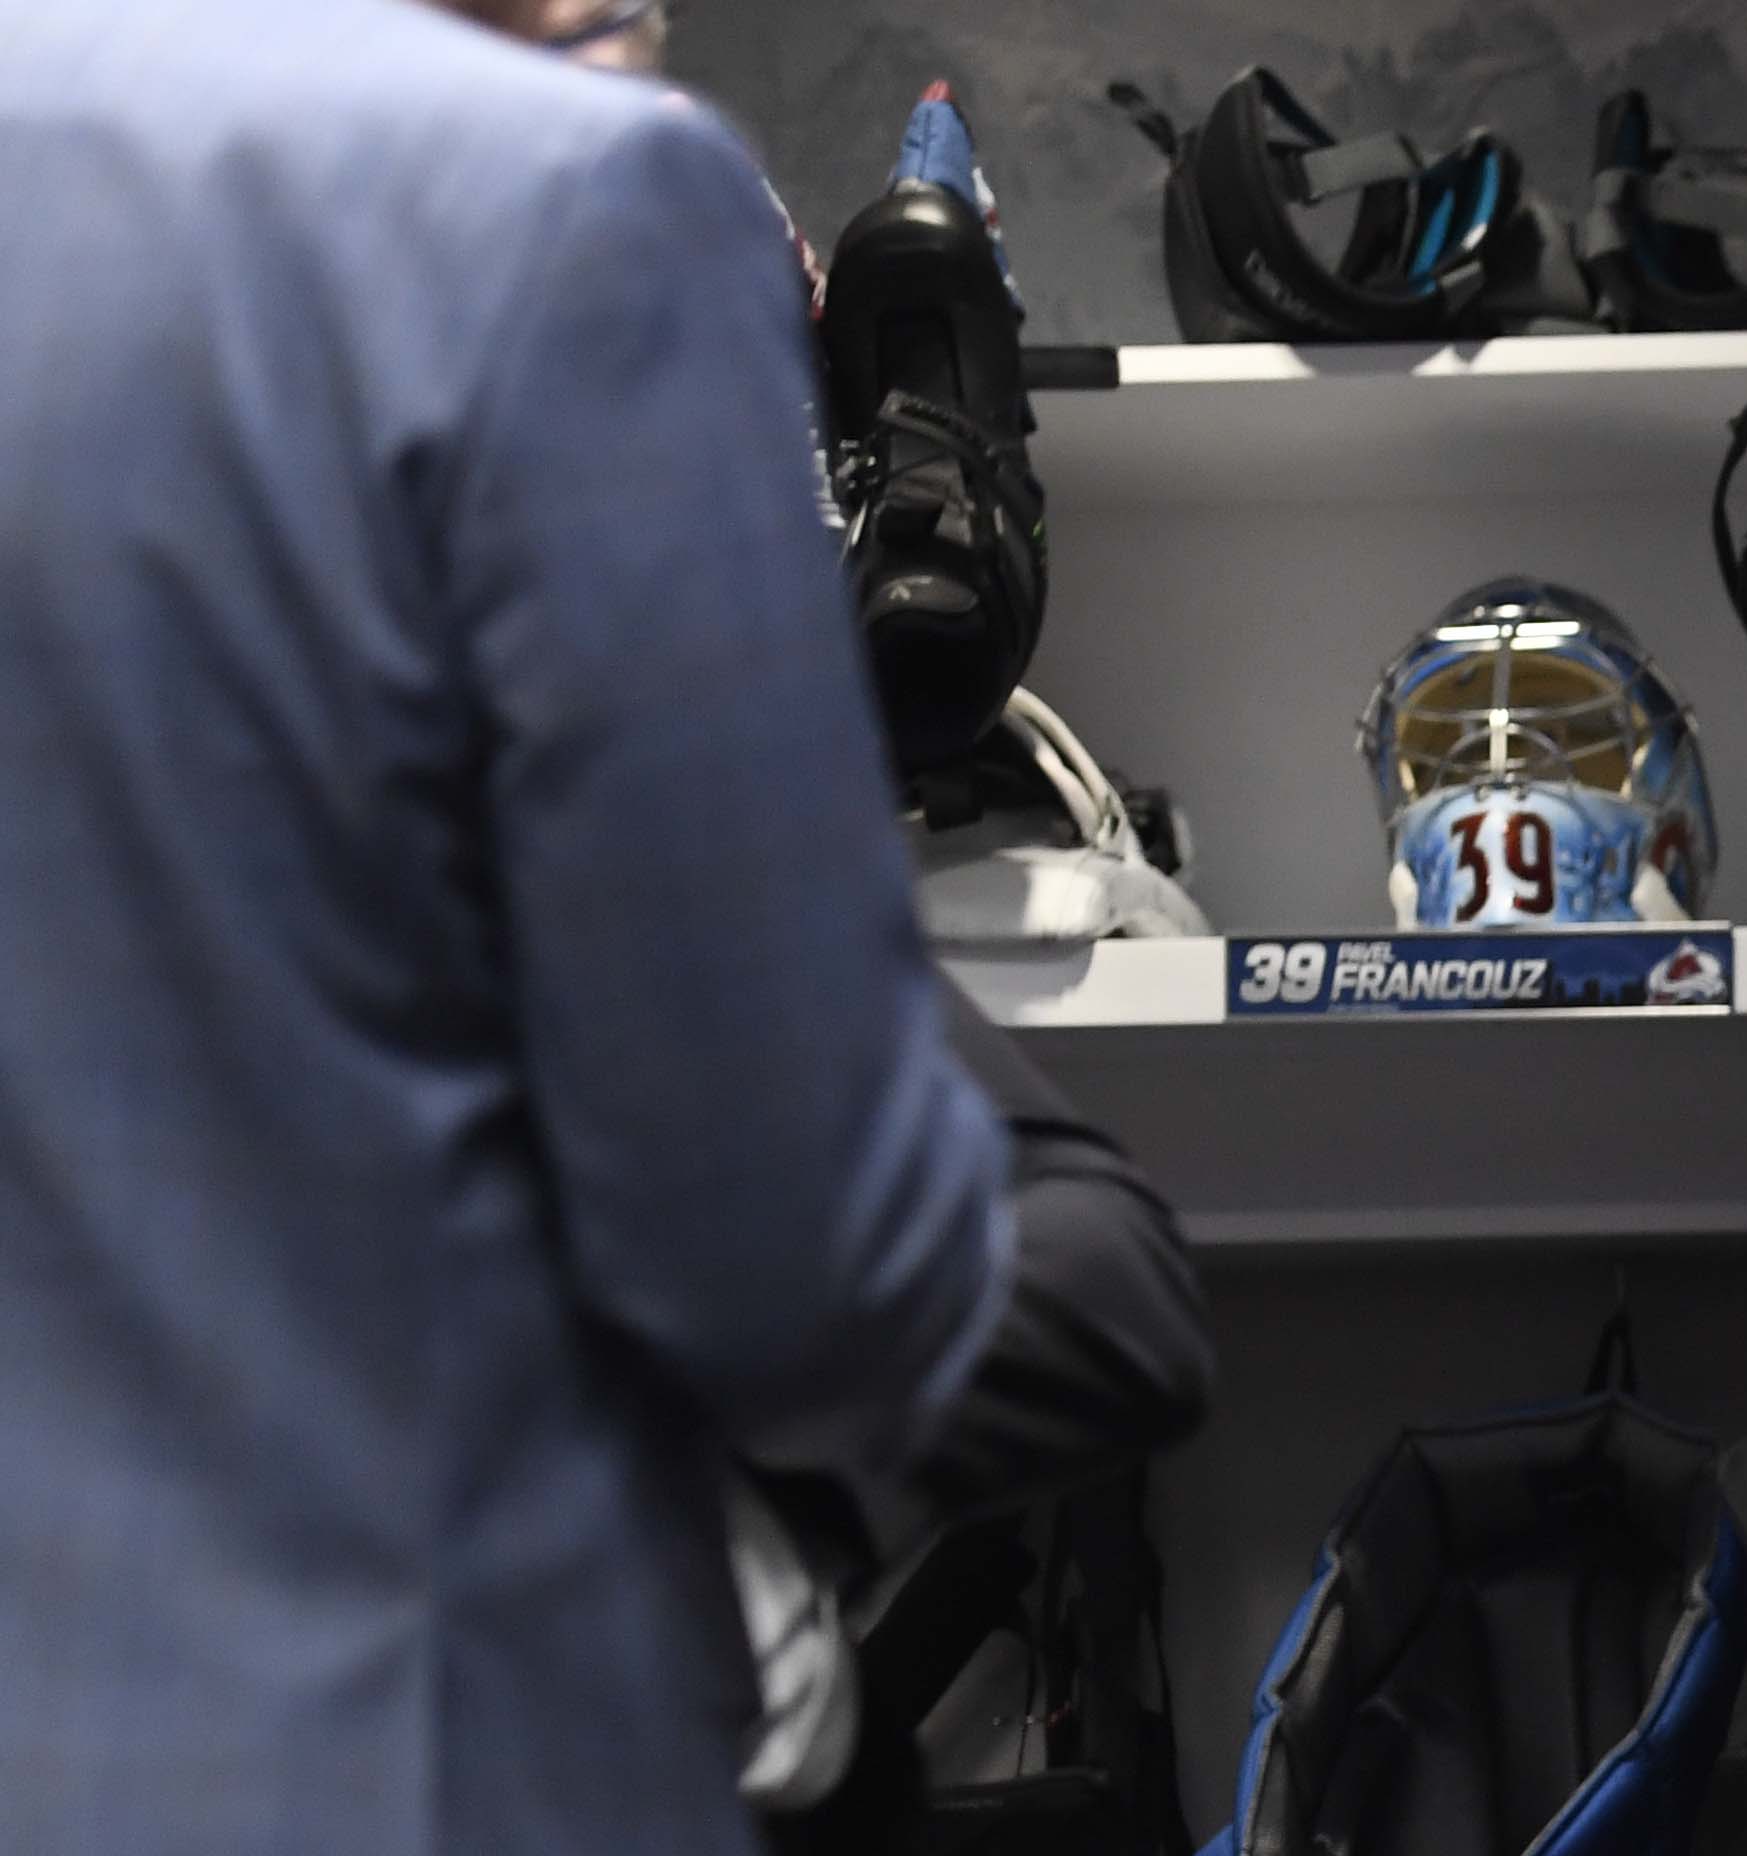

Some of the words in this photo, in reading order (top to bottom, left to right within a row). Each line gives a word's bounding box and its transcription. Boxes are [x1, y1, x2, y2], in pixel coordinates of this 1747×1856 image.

[1450, 811, 1555, 922] 39
[1239, 942, 1327, 1004] 39
[1328, 958, 1548, 1001] FRANCOUZ
